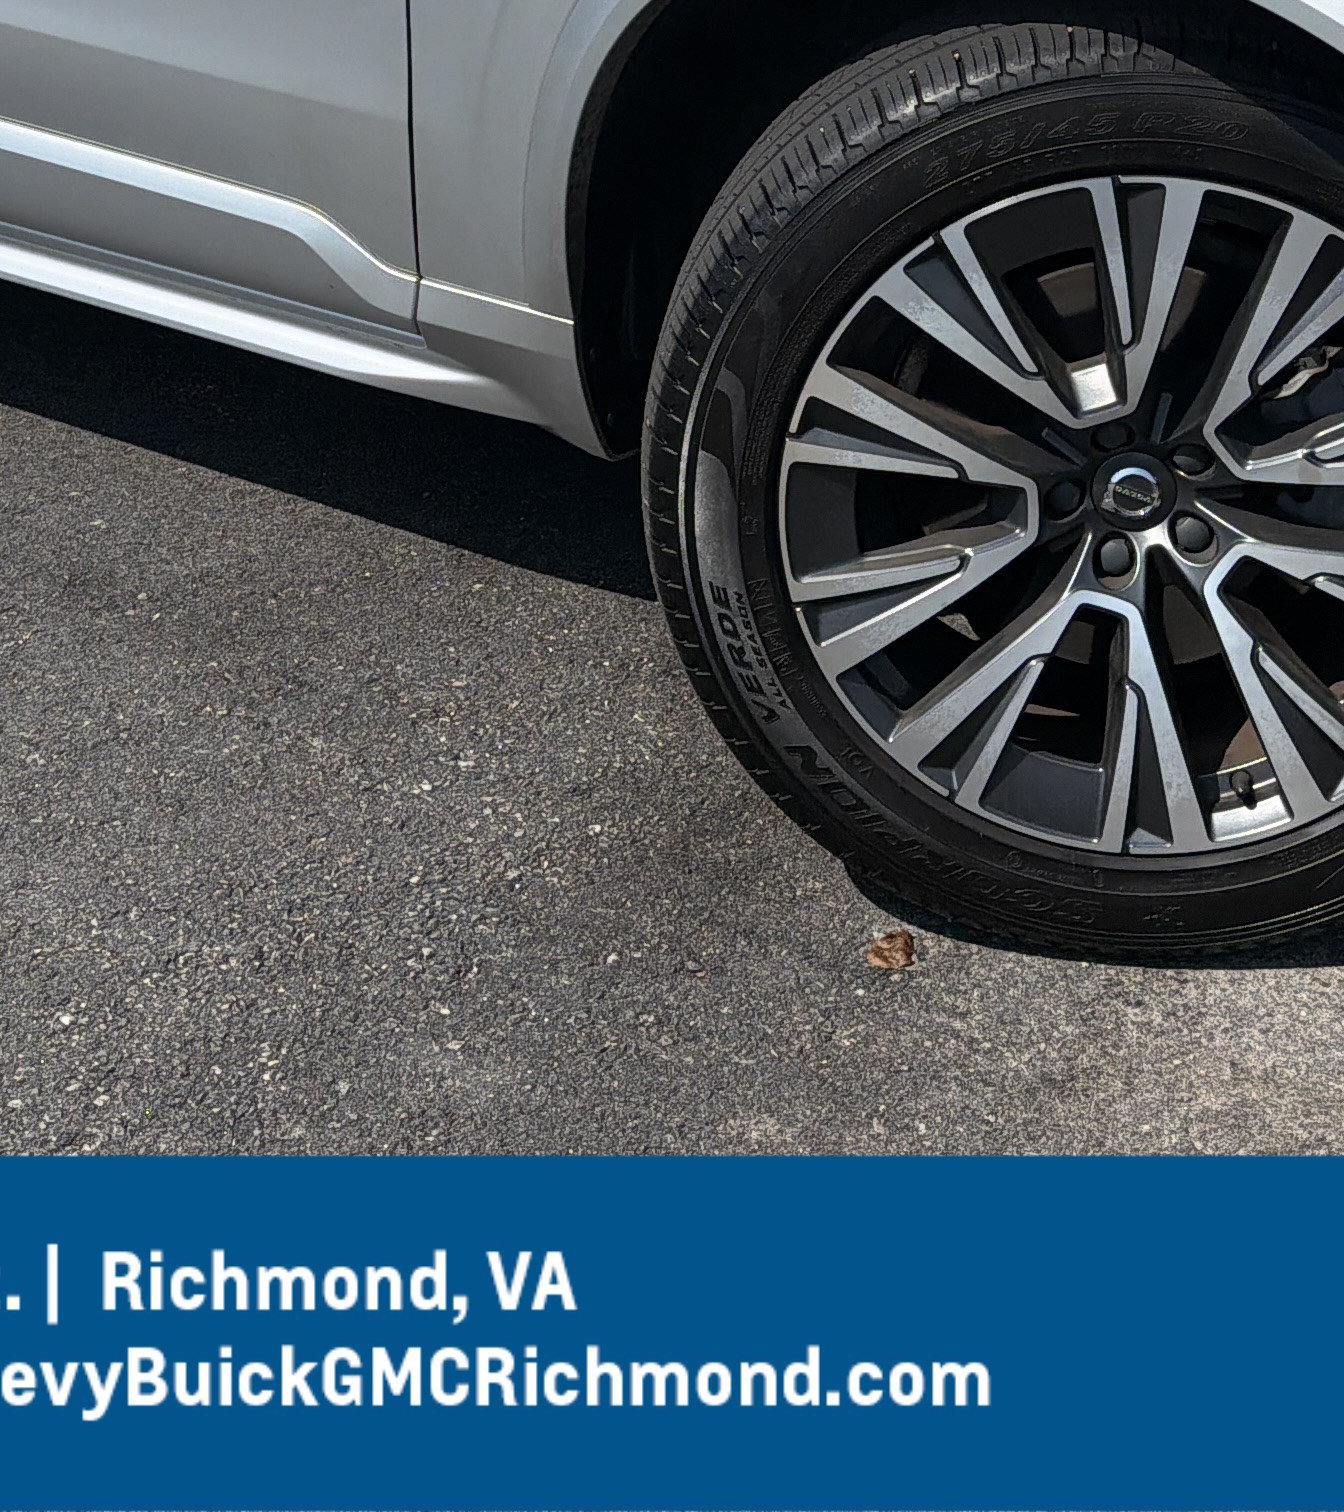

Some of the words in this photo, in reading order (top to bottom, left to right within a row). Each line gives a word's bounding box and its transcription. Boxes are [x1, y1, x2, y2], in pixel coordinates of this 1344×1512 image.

[924, 112, 1120, 189] 275/45
[708, 580, 781, 725] VERDE
[733, 590, 768, 671] SEASON
[767, 678, 792, 711] ALL
